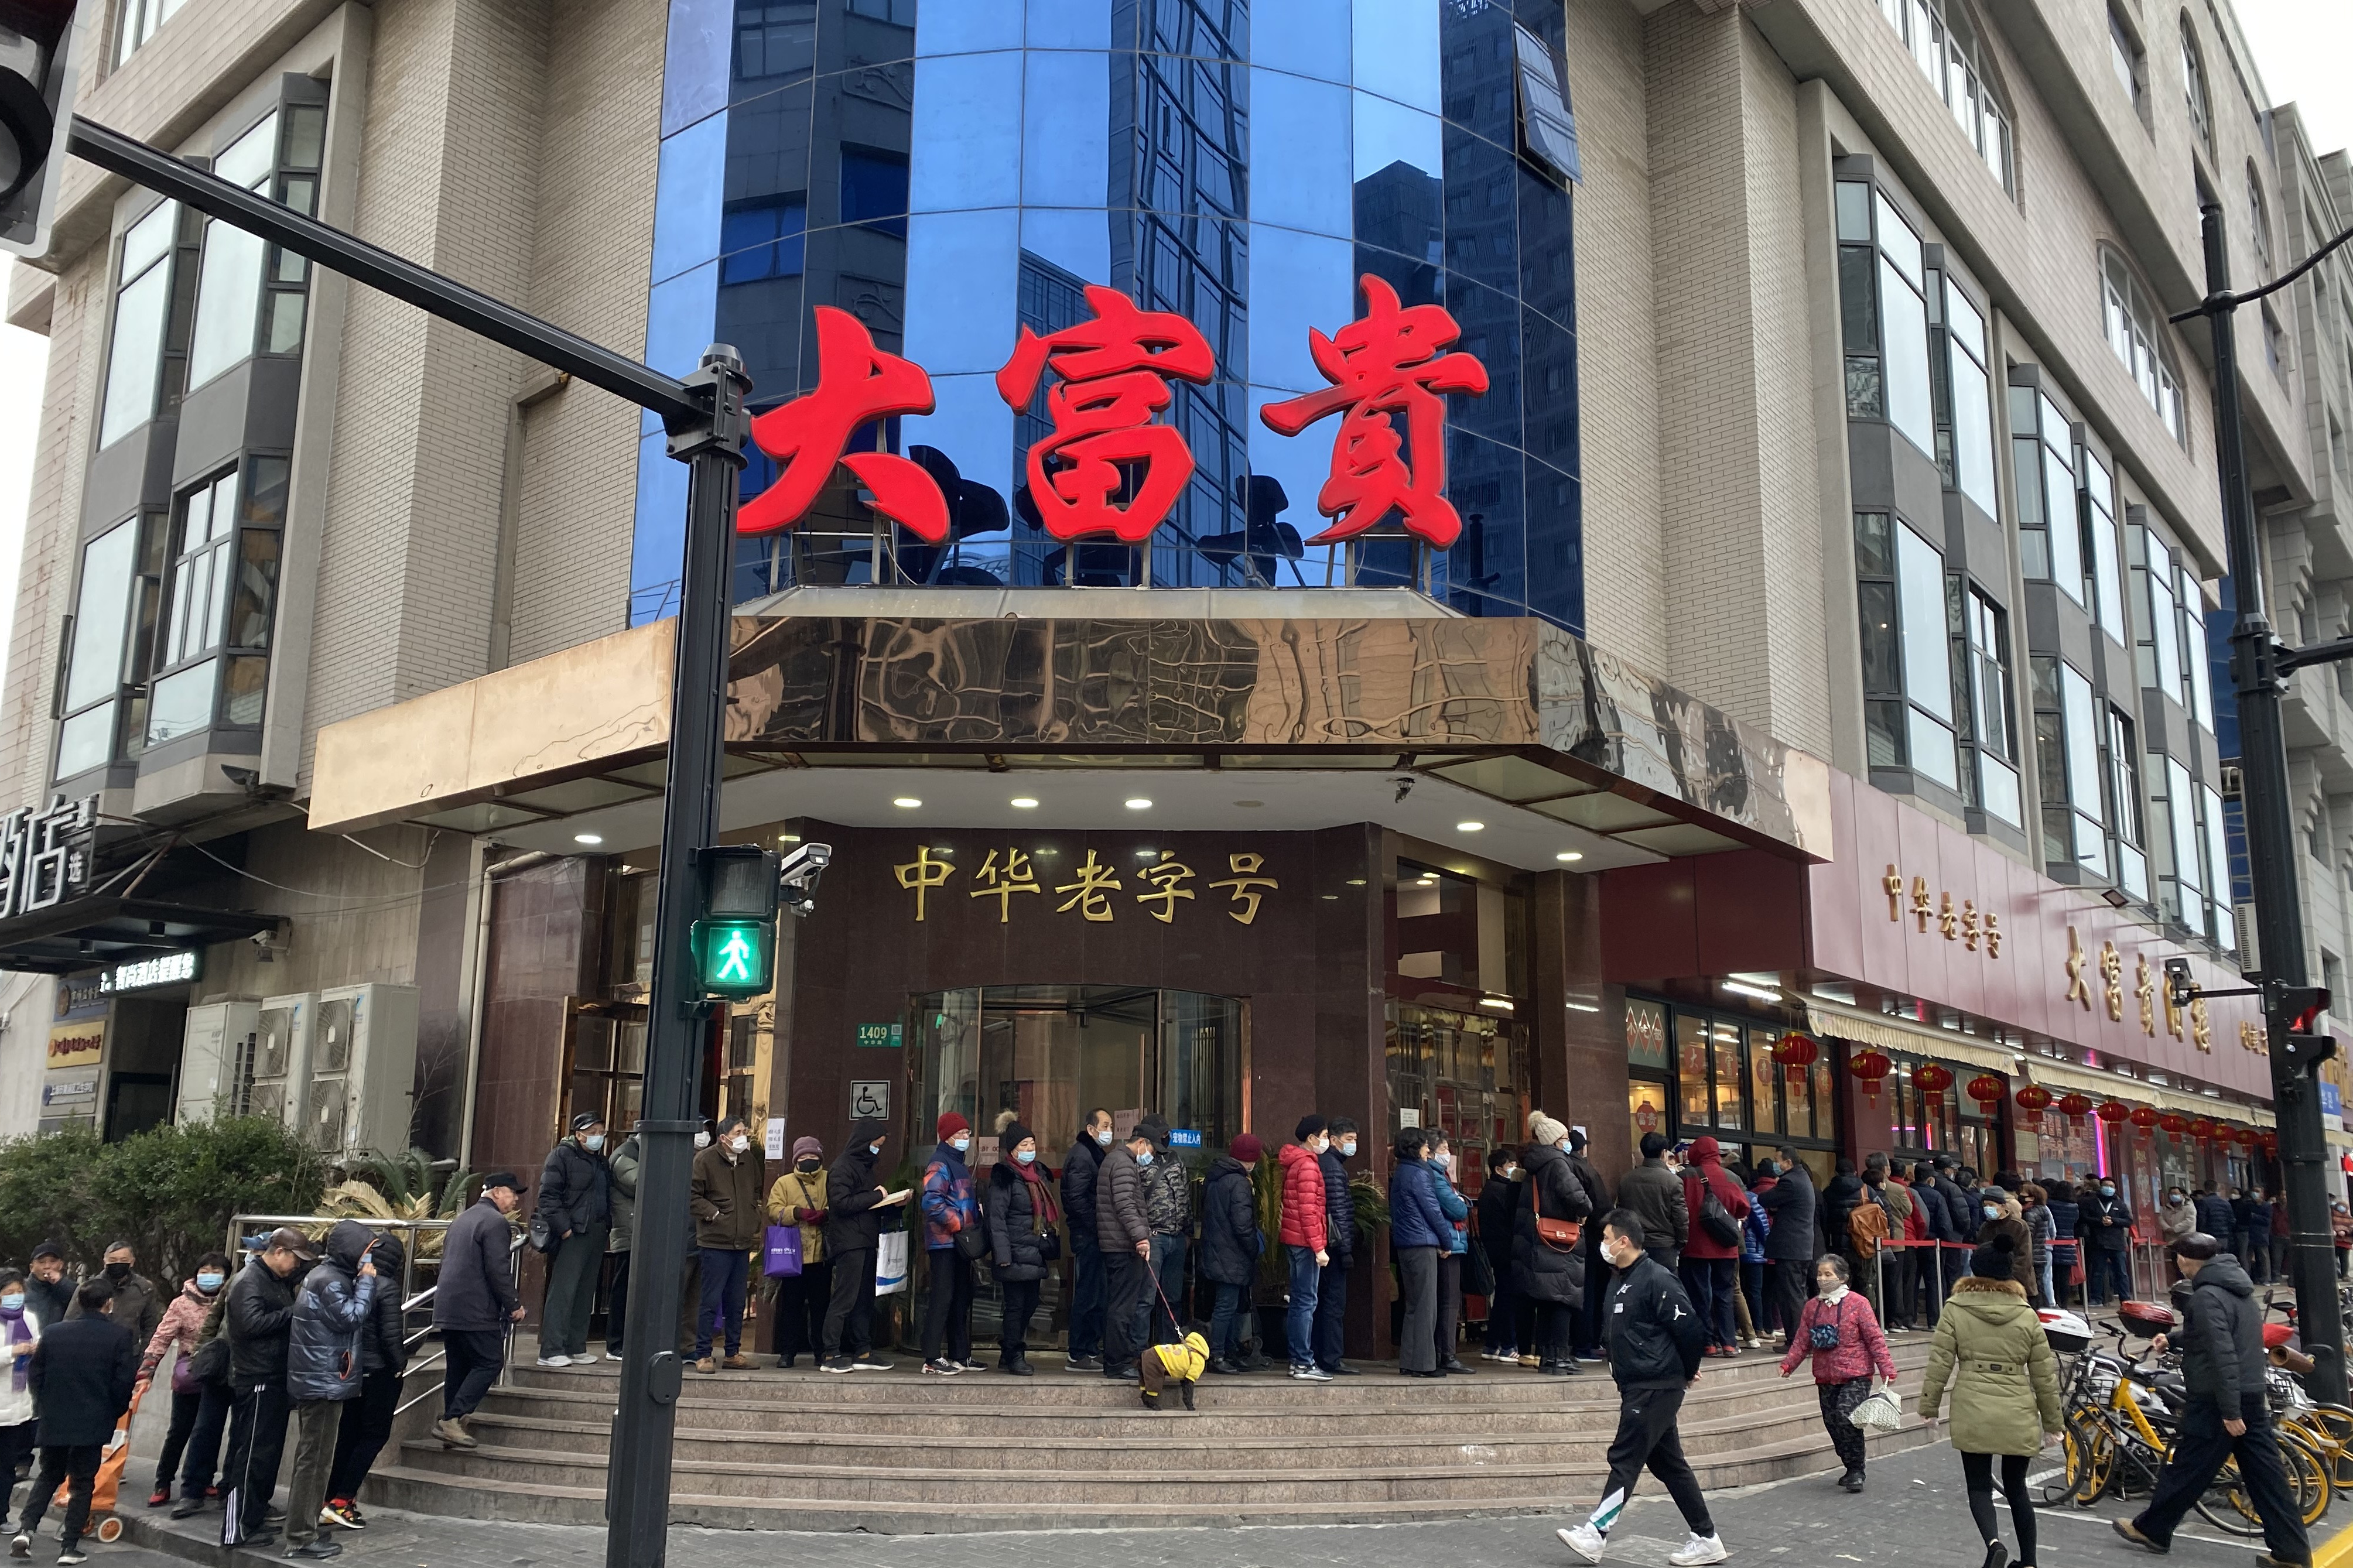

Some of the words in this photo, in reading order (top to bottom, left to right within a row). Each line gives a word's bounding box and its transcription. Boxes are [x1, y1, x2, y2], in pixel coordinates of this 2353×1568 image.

[894, 845, 1278, 925] 中华老字号
[1882, 862, 2002, 959] 中华老字号
[860, 1026, 887, 1039] 1409
[1172, 1132, 1201, 1145] 宠物禁止入内
